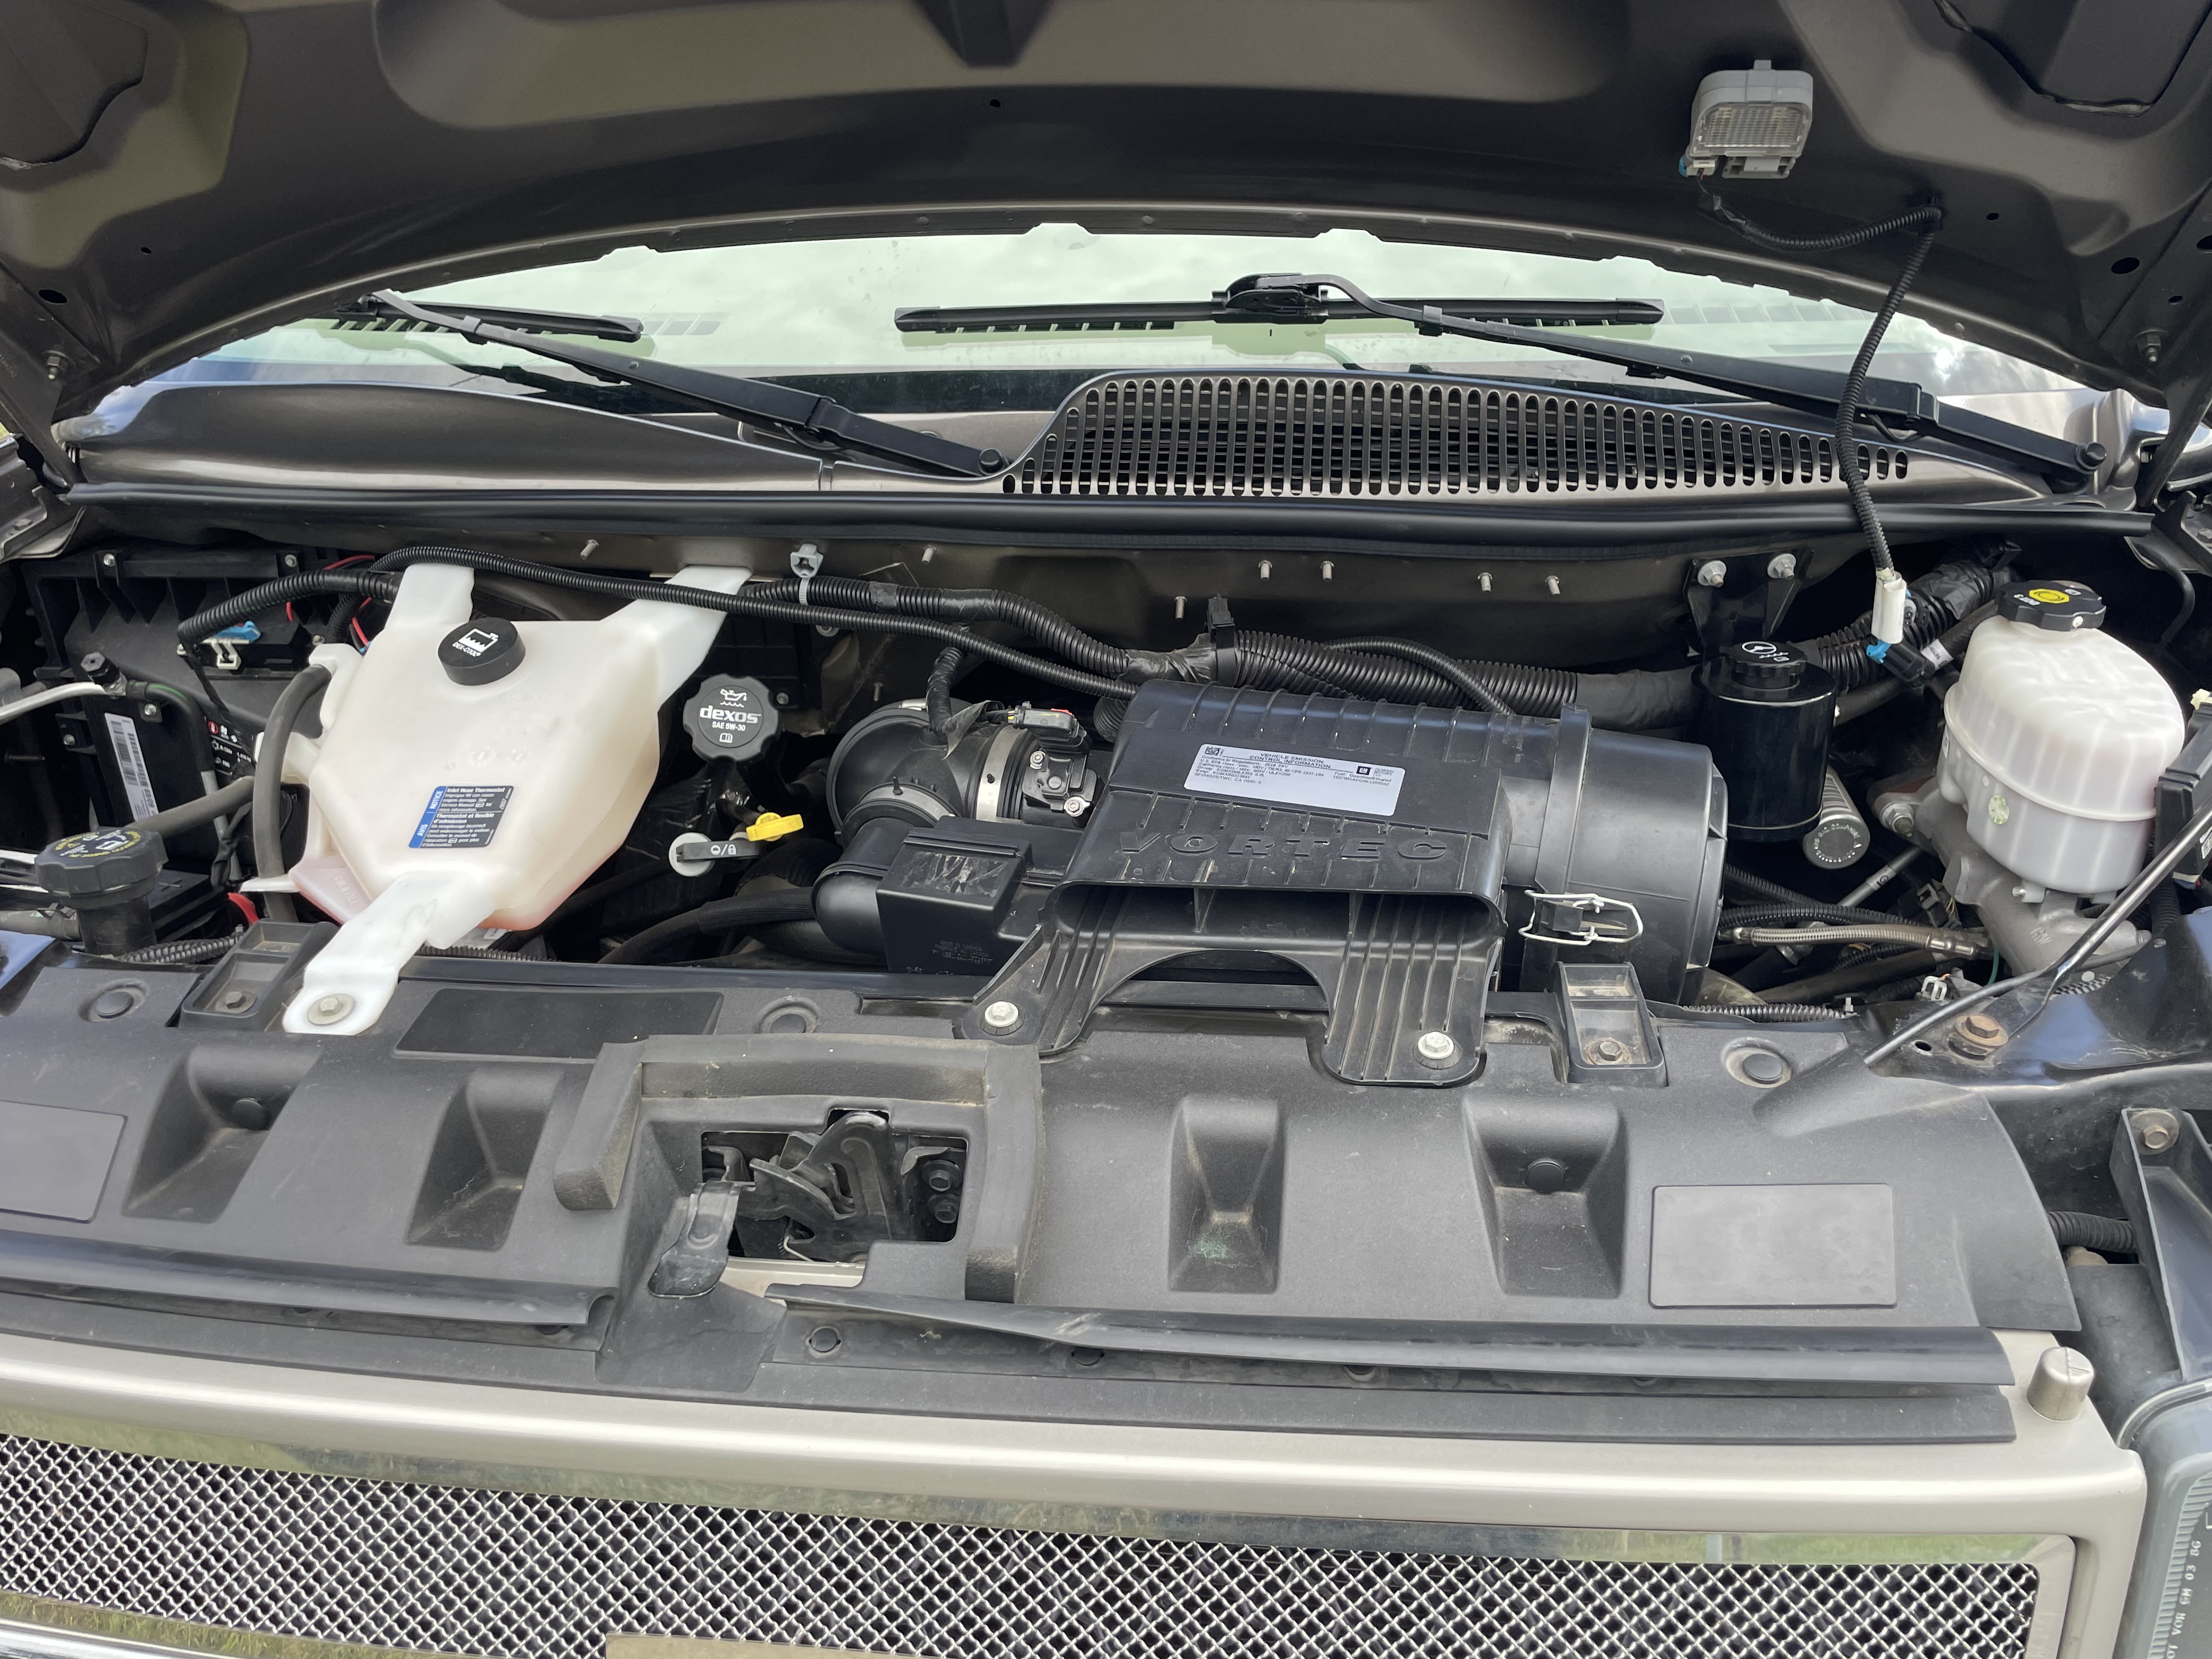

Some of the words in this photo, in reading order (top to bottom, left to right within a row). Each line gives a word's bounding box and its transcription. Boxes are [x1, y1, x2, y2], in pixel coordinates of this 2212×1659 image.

[725, 723, 746, 731] 5W-30
[1283, 759, 1331, 769] INFORMATION
[430, 790, 443, 809] NOTICE
[417, 823, 428, 837] AVIS
[1120, 832, 1448, 861] VORTEC
[2171, 1612, 2186, 1636] VOR
[2185, 1564, 2196, 1580] 03
